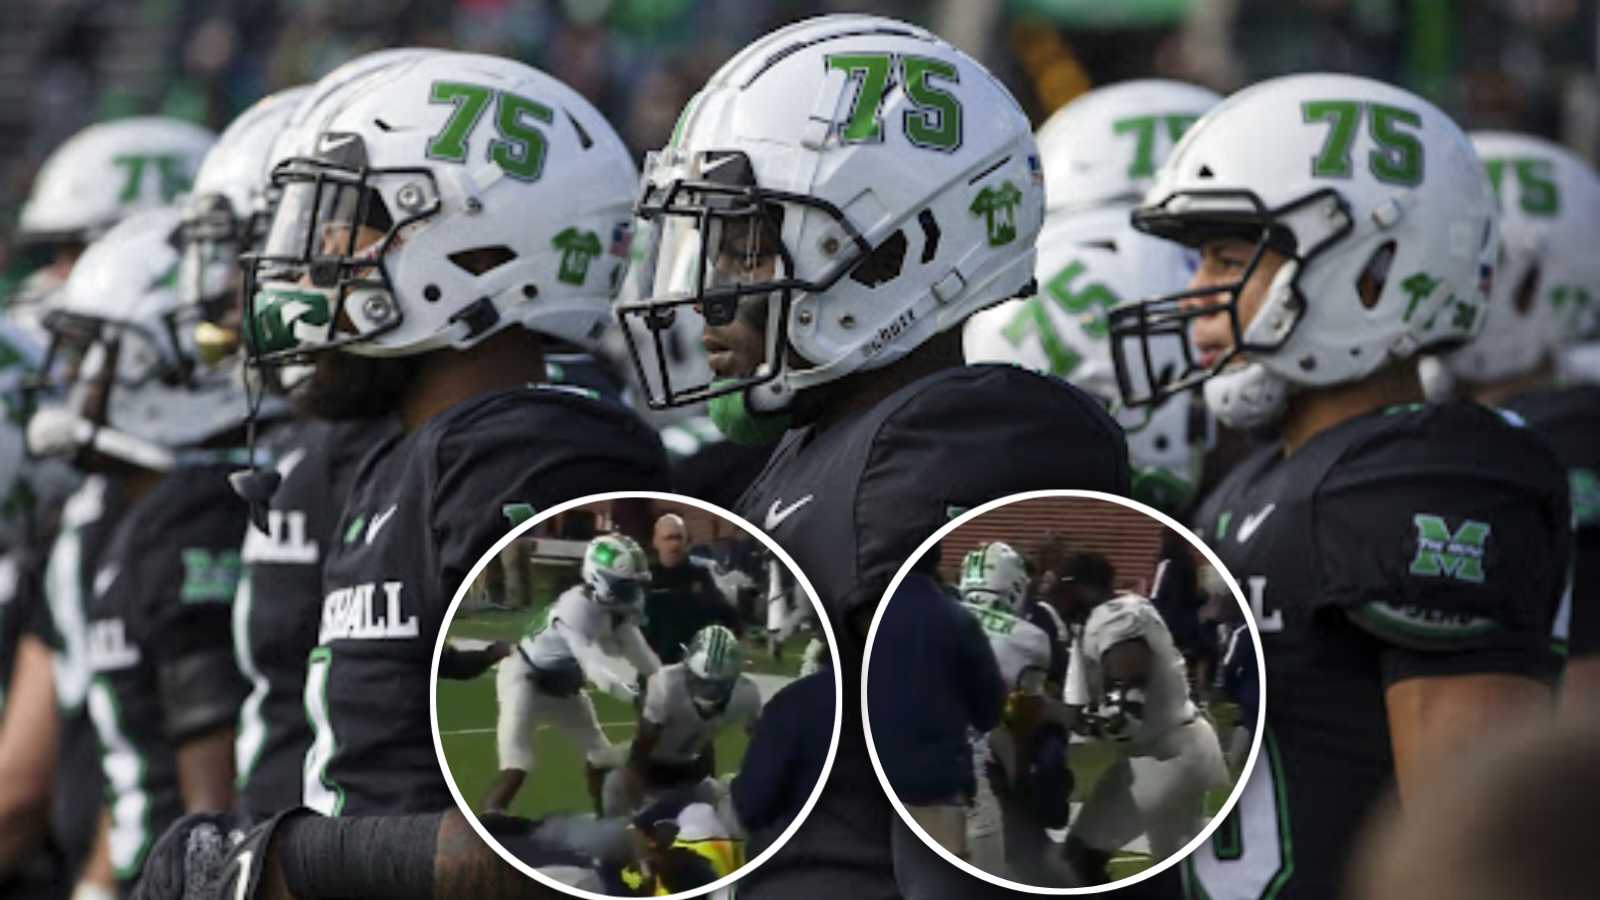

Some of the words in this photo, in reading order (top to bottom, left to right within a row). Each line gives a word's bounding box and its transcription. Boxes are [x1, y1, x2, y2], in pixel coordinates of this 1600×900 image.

[425, 79, 554, 184] 75
[823, 53, 963, 154] 75
[1301, 99, 1425, 189] 75
[1409, 512, 1491, 583] M
